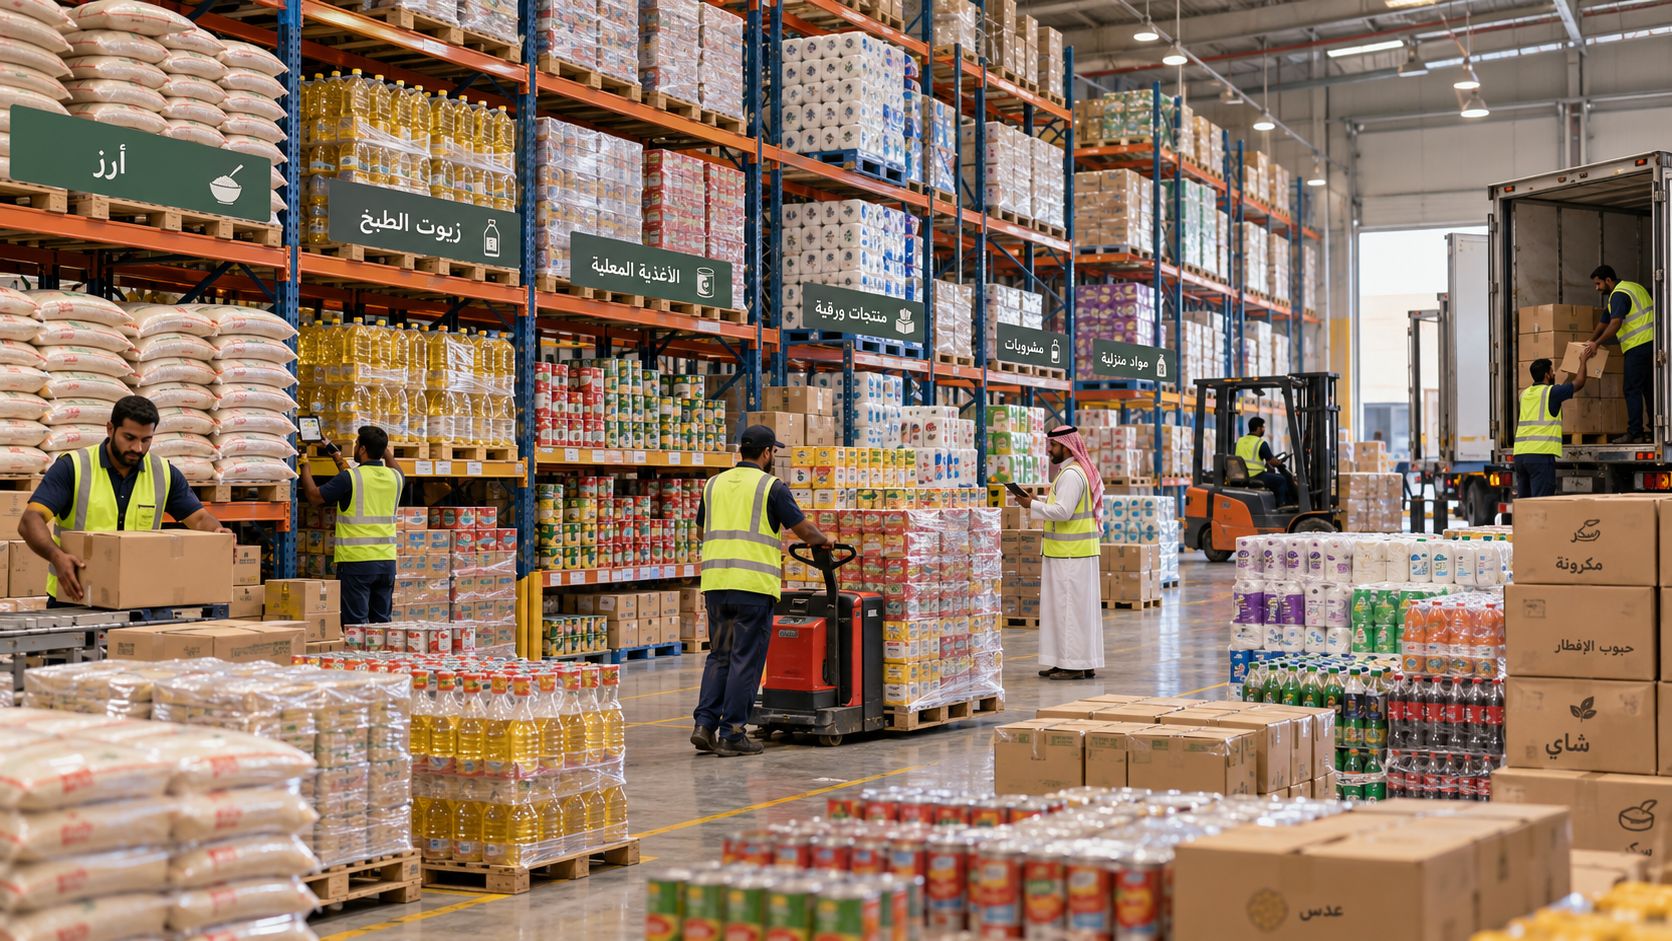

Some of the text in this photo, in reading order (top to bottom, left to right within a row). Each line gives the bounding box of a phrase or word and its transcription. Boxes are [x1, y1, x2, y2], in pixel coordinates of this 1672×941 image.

[92, 143, 126, 180] أرز
[360, 209, 461, 243] زيوت الطبخ
[639, 263, 680, 284] الأغذية
[815, 300, 887, 324] منتجات ورقية
[1129, 355, 1149, 370] مواد
[1555, 556, 1603, 574] مكرونة
[1553, 639, 1634, 656] حبوب الإفطار
[1545, 732, 1590, 760] شاي
[1299, 904, 1345, 922] عدس
